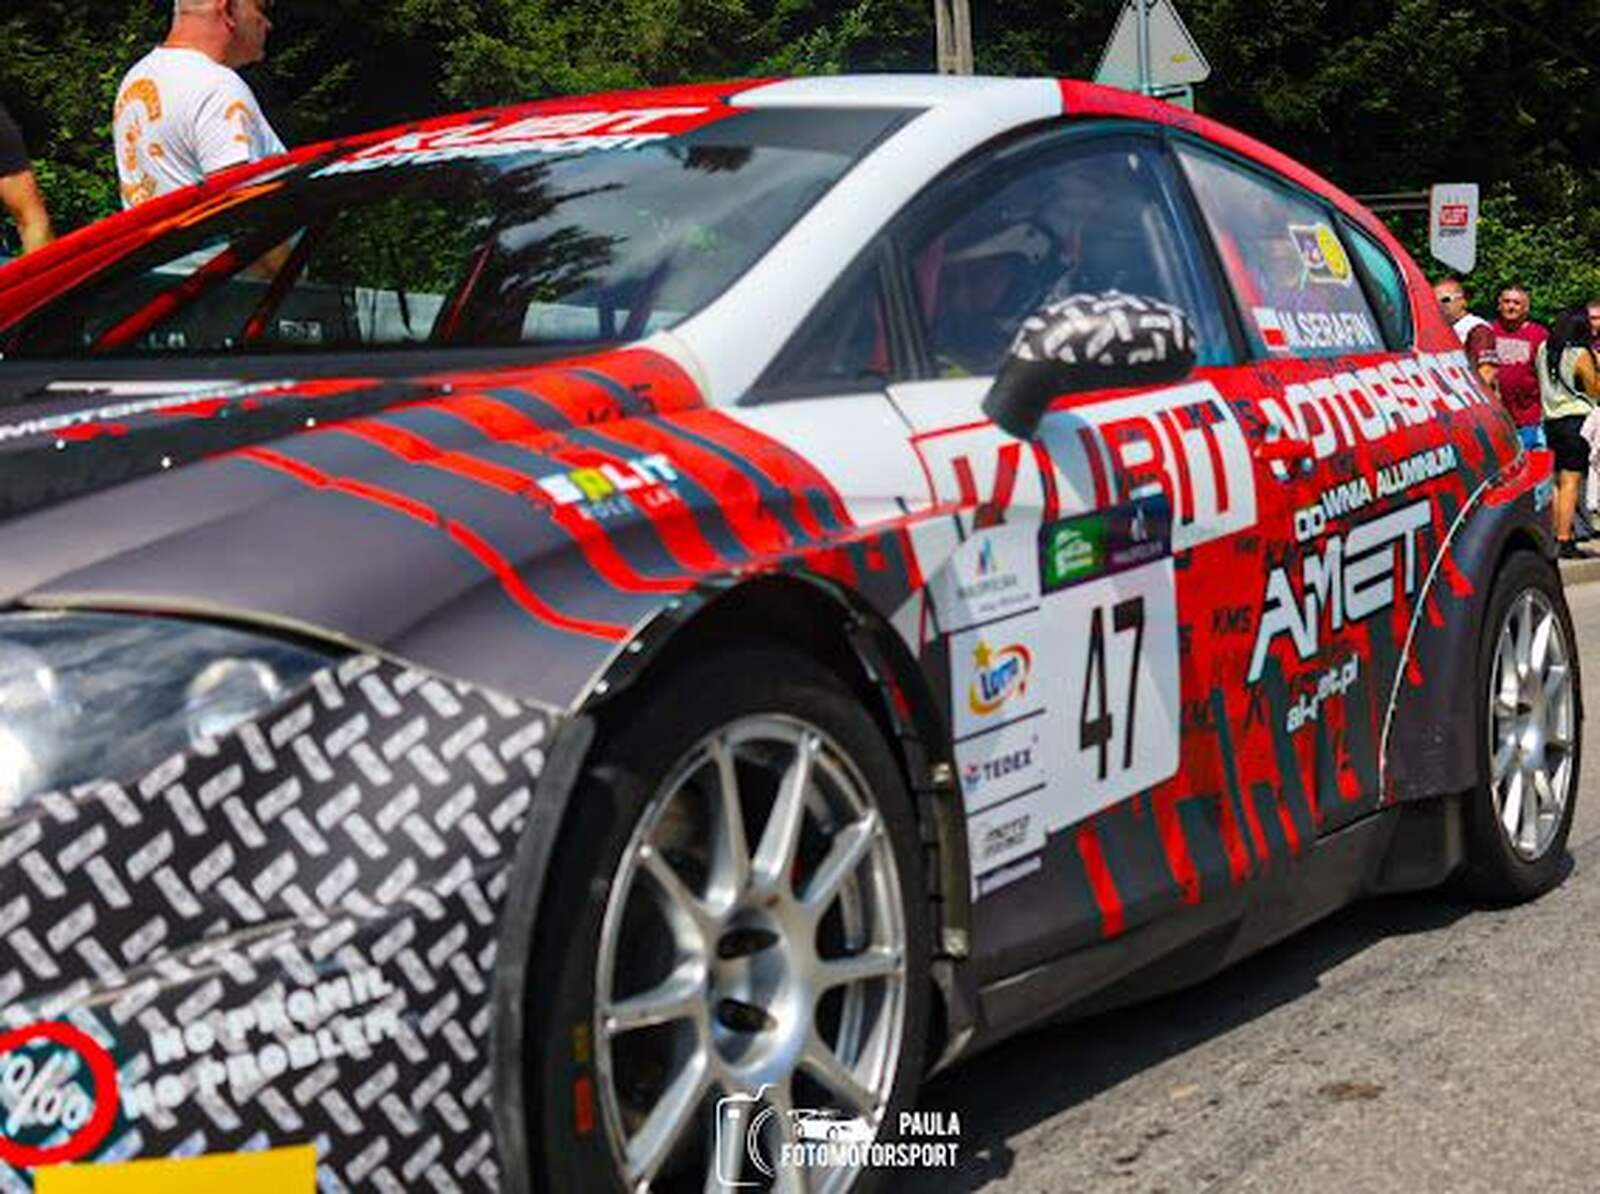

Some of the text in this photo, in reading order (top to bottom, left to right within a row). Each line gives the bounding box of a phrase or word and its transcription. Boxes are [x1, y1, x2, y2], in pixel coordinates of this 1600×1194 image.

[1247, 499, 1432, 684] AMET
[982, 749, 1033, 781] TEDEX
[1080, 596, 1144, 781] 47
